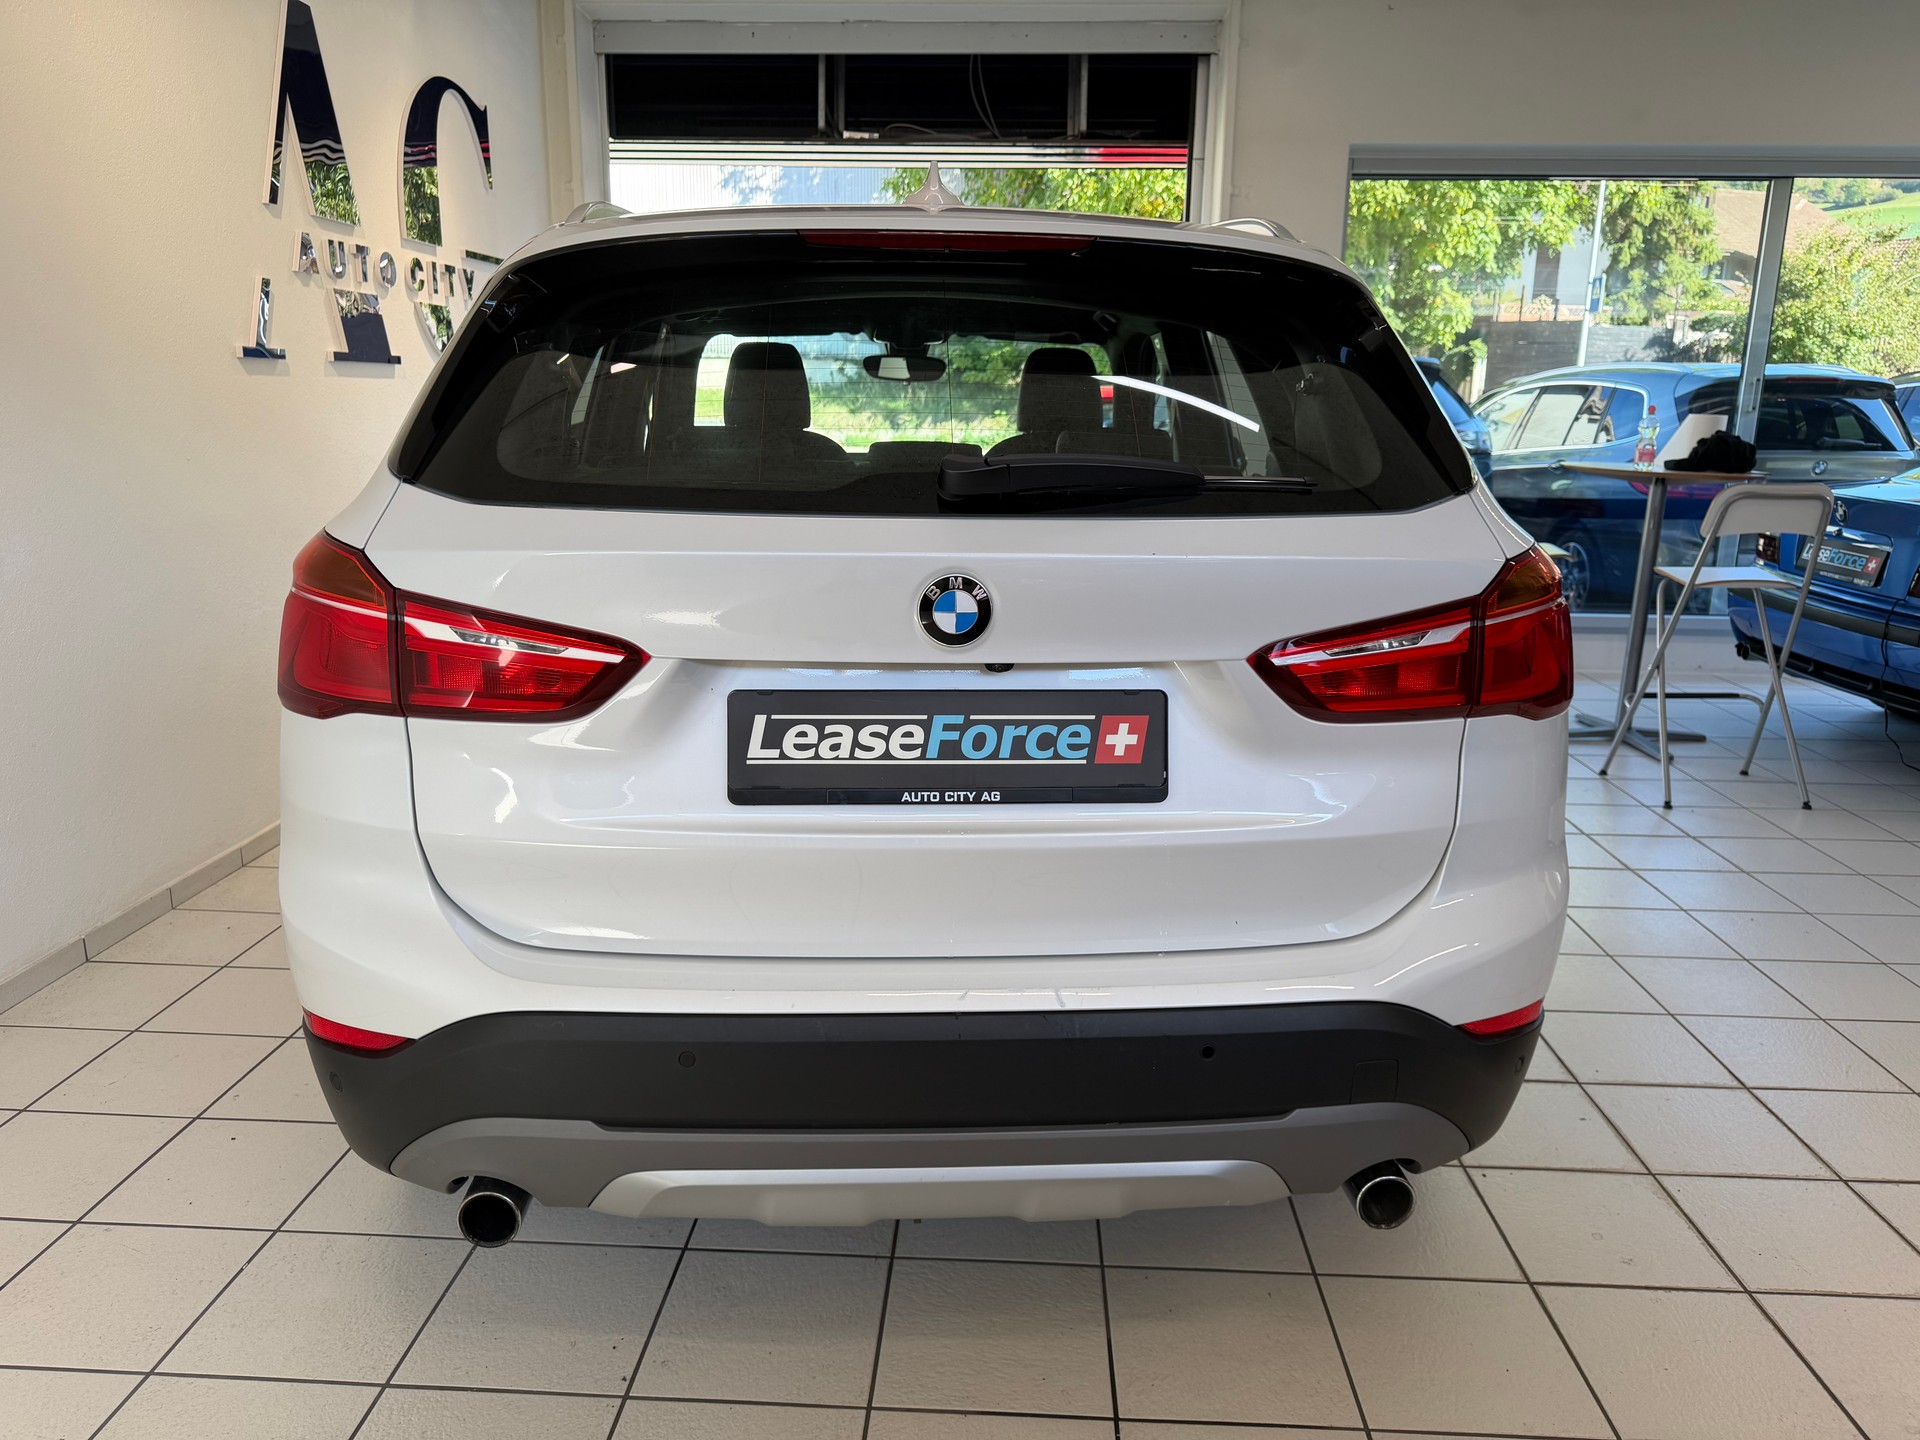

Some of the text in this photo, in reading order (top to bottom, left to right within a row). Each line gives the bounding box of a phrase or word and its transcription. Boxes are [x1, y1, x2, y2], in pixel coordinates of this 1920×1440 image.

[292, 231, 475, 300] AUTO CITY
[1802, 543, 1867, 570] LseForce
[926, 577, 987, 601] BMW
[746, 714, 1092, 760] LeaseForce
[901, 791, 1001, 802] AUTO CITY AG
